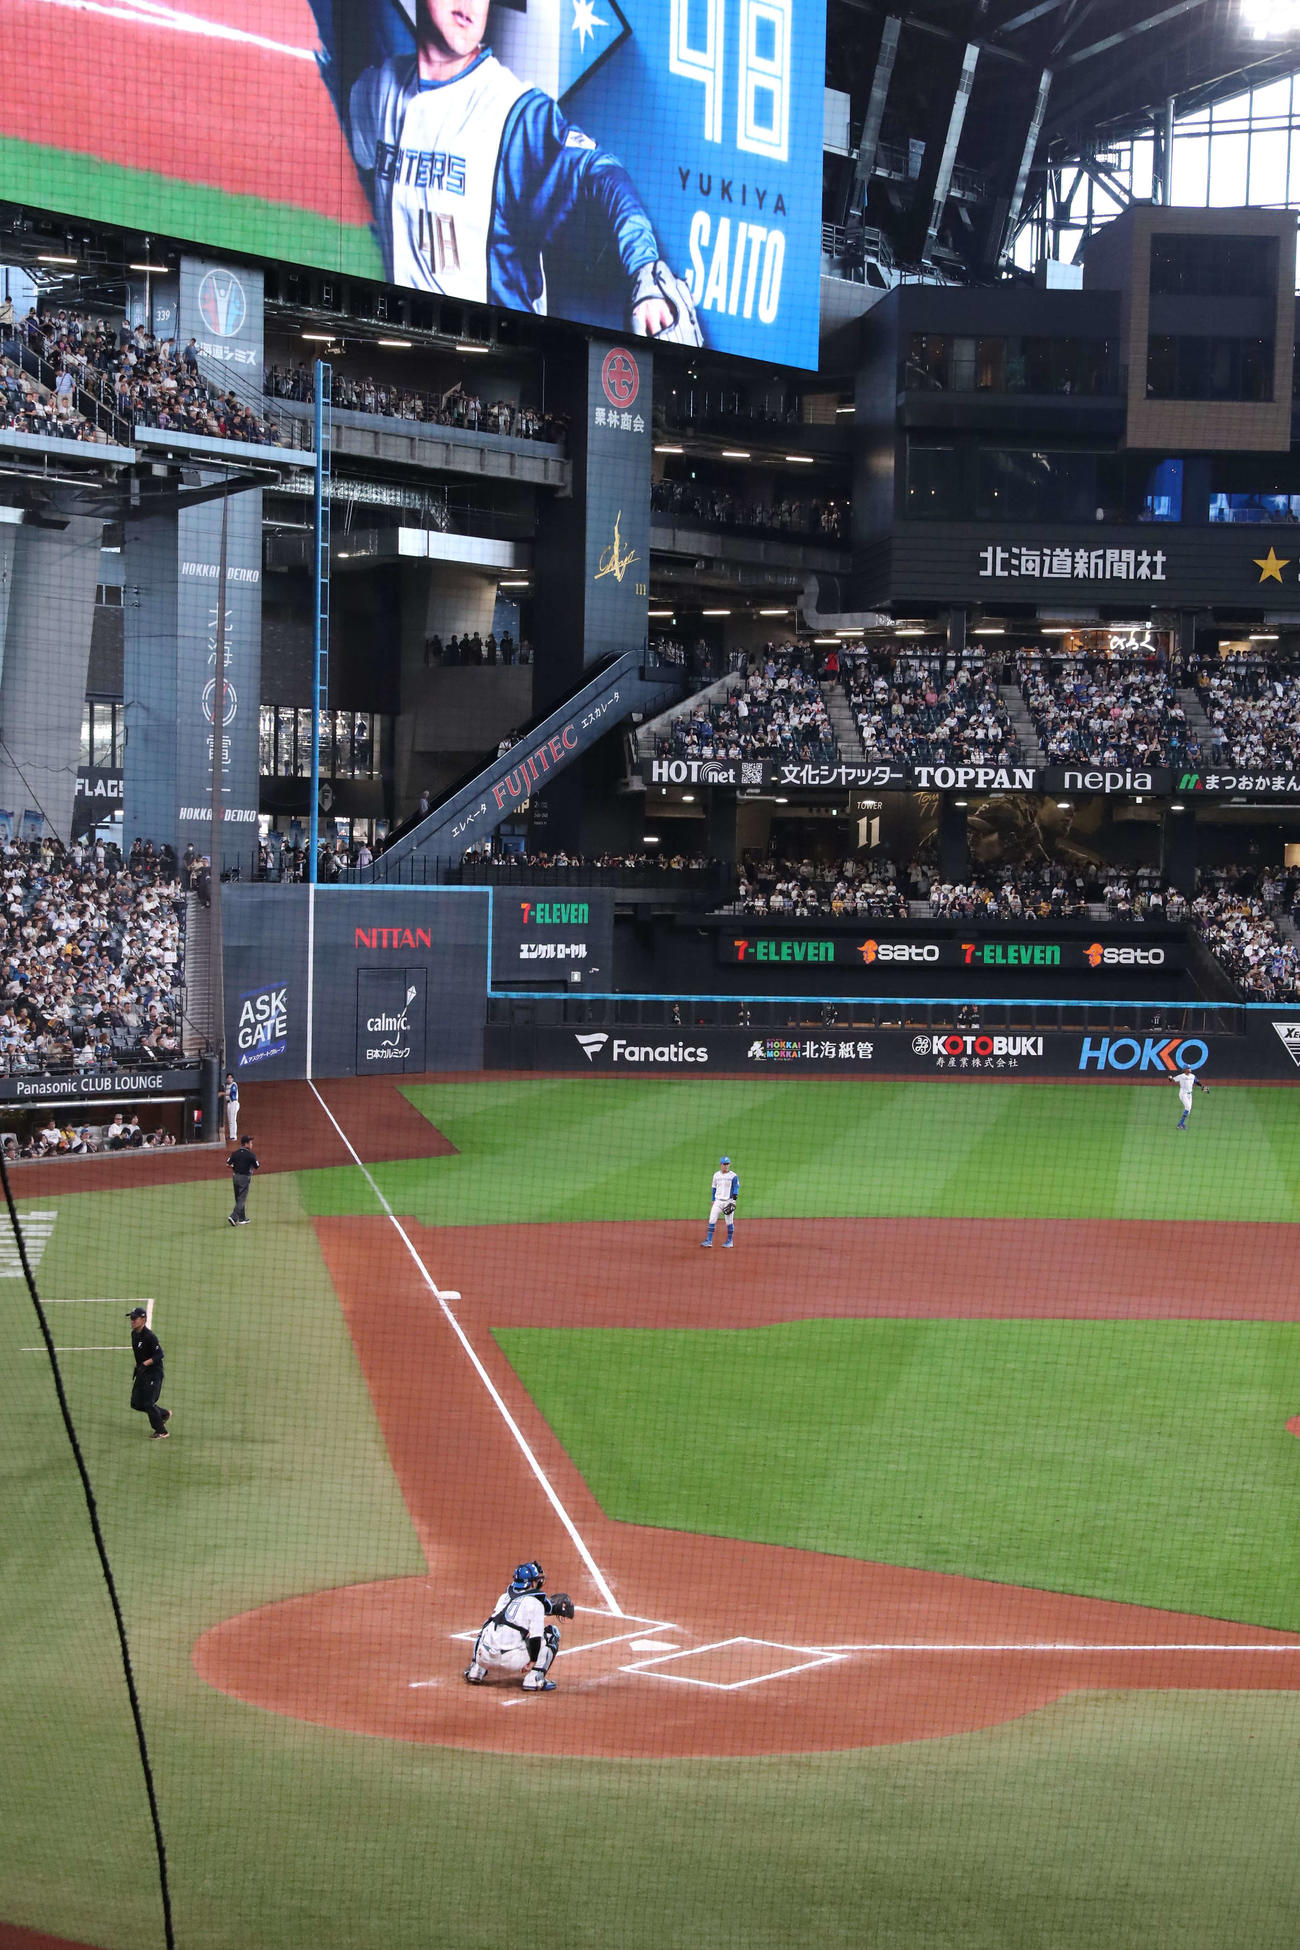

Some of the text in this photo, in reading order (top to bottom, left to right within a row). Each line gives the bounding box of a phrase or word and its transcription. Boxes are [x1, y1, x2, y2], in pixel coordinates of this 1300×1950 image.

[669, 0, 792, 162] 48
[678, 166, 786, 217] YUKIYA
[685, 210, 786, 324] SAITO
[156, 310, 170, 322] 339
[594, 407, 645, 434] 栗林商会
[979, 546, 1166, 581] 北海道新聞社
[227, 567, 260, 583] DENKO
[581, 692, 620, 729] エスカレータ
[492, 724, 578, 809] FUJITEC
[914, 767, 1036, 789] TOPPAN
[1064, 768, 1152, 793] nepia
[223, 809, 257, 822] DENKO
[856, 801, 883, 810] TOWER
[451, 803, 487, 838] エレベータ
[856, 816, 880, 849] 11
[355, 927, 431, 949] NITTAN
[877, 944, 940, 961] sato
[1103, 948, 1165, 964] sato
[239, 988, 287, 1027] ASK
[238, 1015, 287, 1049] GATE
[367, 1013, 408, 1031] calmic
[366, 1047, 411, 1060] 日本カルミック
[612, 1039, 709, 1062] Fanatics
[766, 1041, 801, 1049] HOKKAI
[801, 1040, 874, 1060] 北海紙管
[932, 1035, 1044, 1056] KOTOBUKI
[1079, 1037, 1209, 1070] HOKKO
[936, 1056, 1019, 1068] 寿産業株式会社
[17, 1075, 163, 1096] Panasonic CLUB LOUNGE
